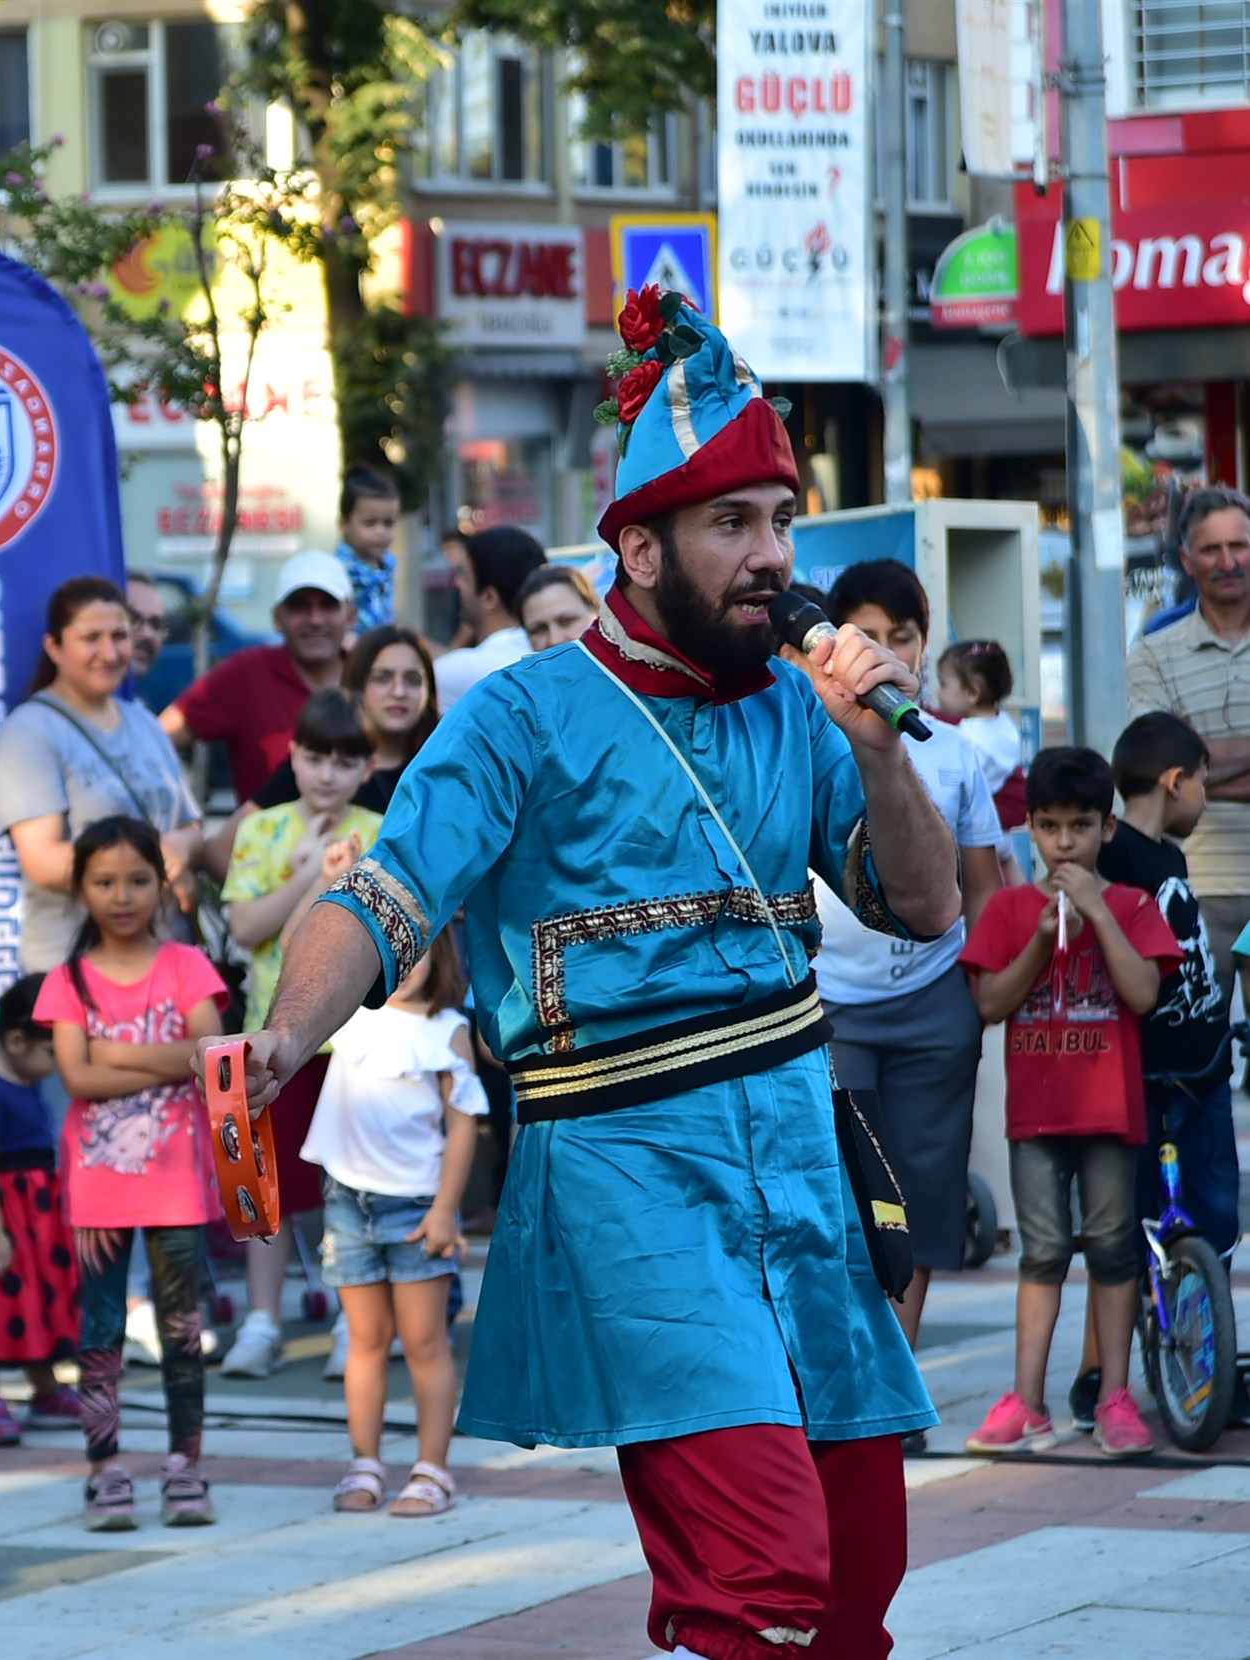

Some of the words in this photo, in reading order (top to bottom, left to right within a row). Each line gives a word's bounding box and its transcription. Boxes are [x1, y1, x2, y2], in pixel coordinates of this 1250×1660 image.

[751, 31, 837, 54] YALOVA
[735, 70, 852, 119] GÜÇLÜ
[452, 238, 578, 299] ECZANE
